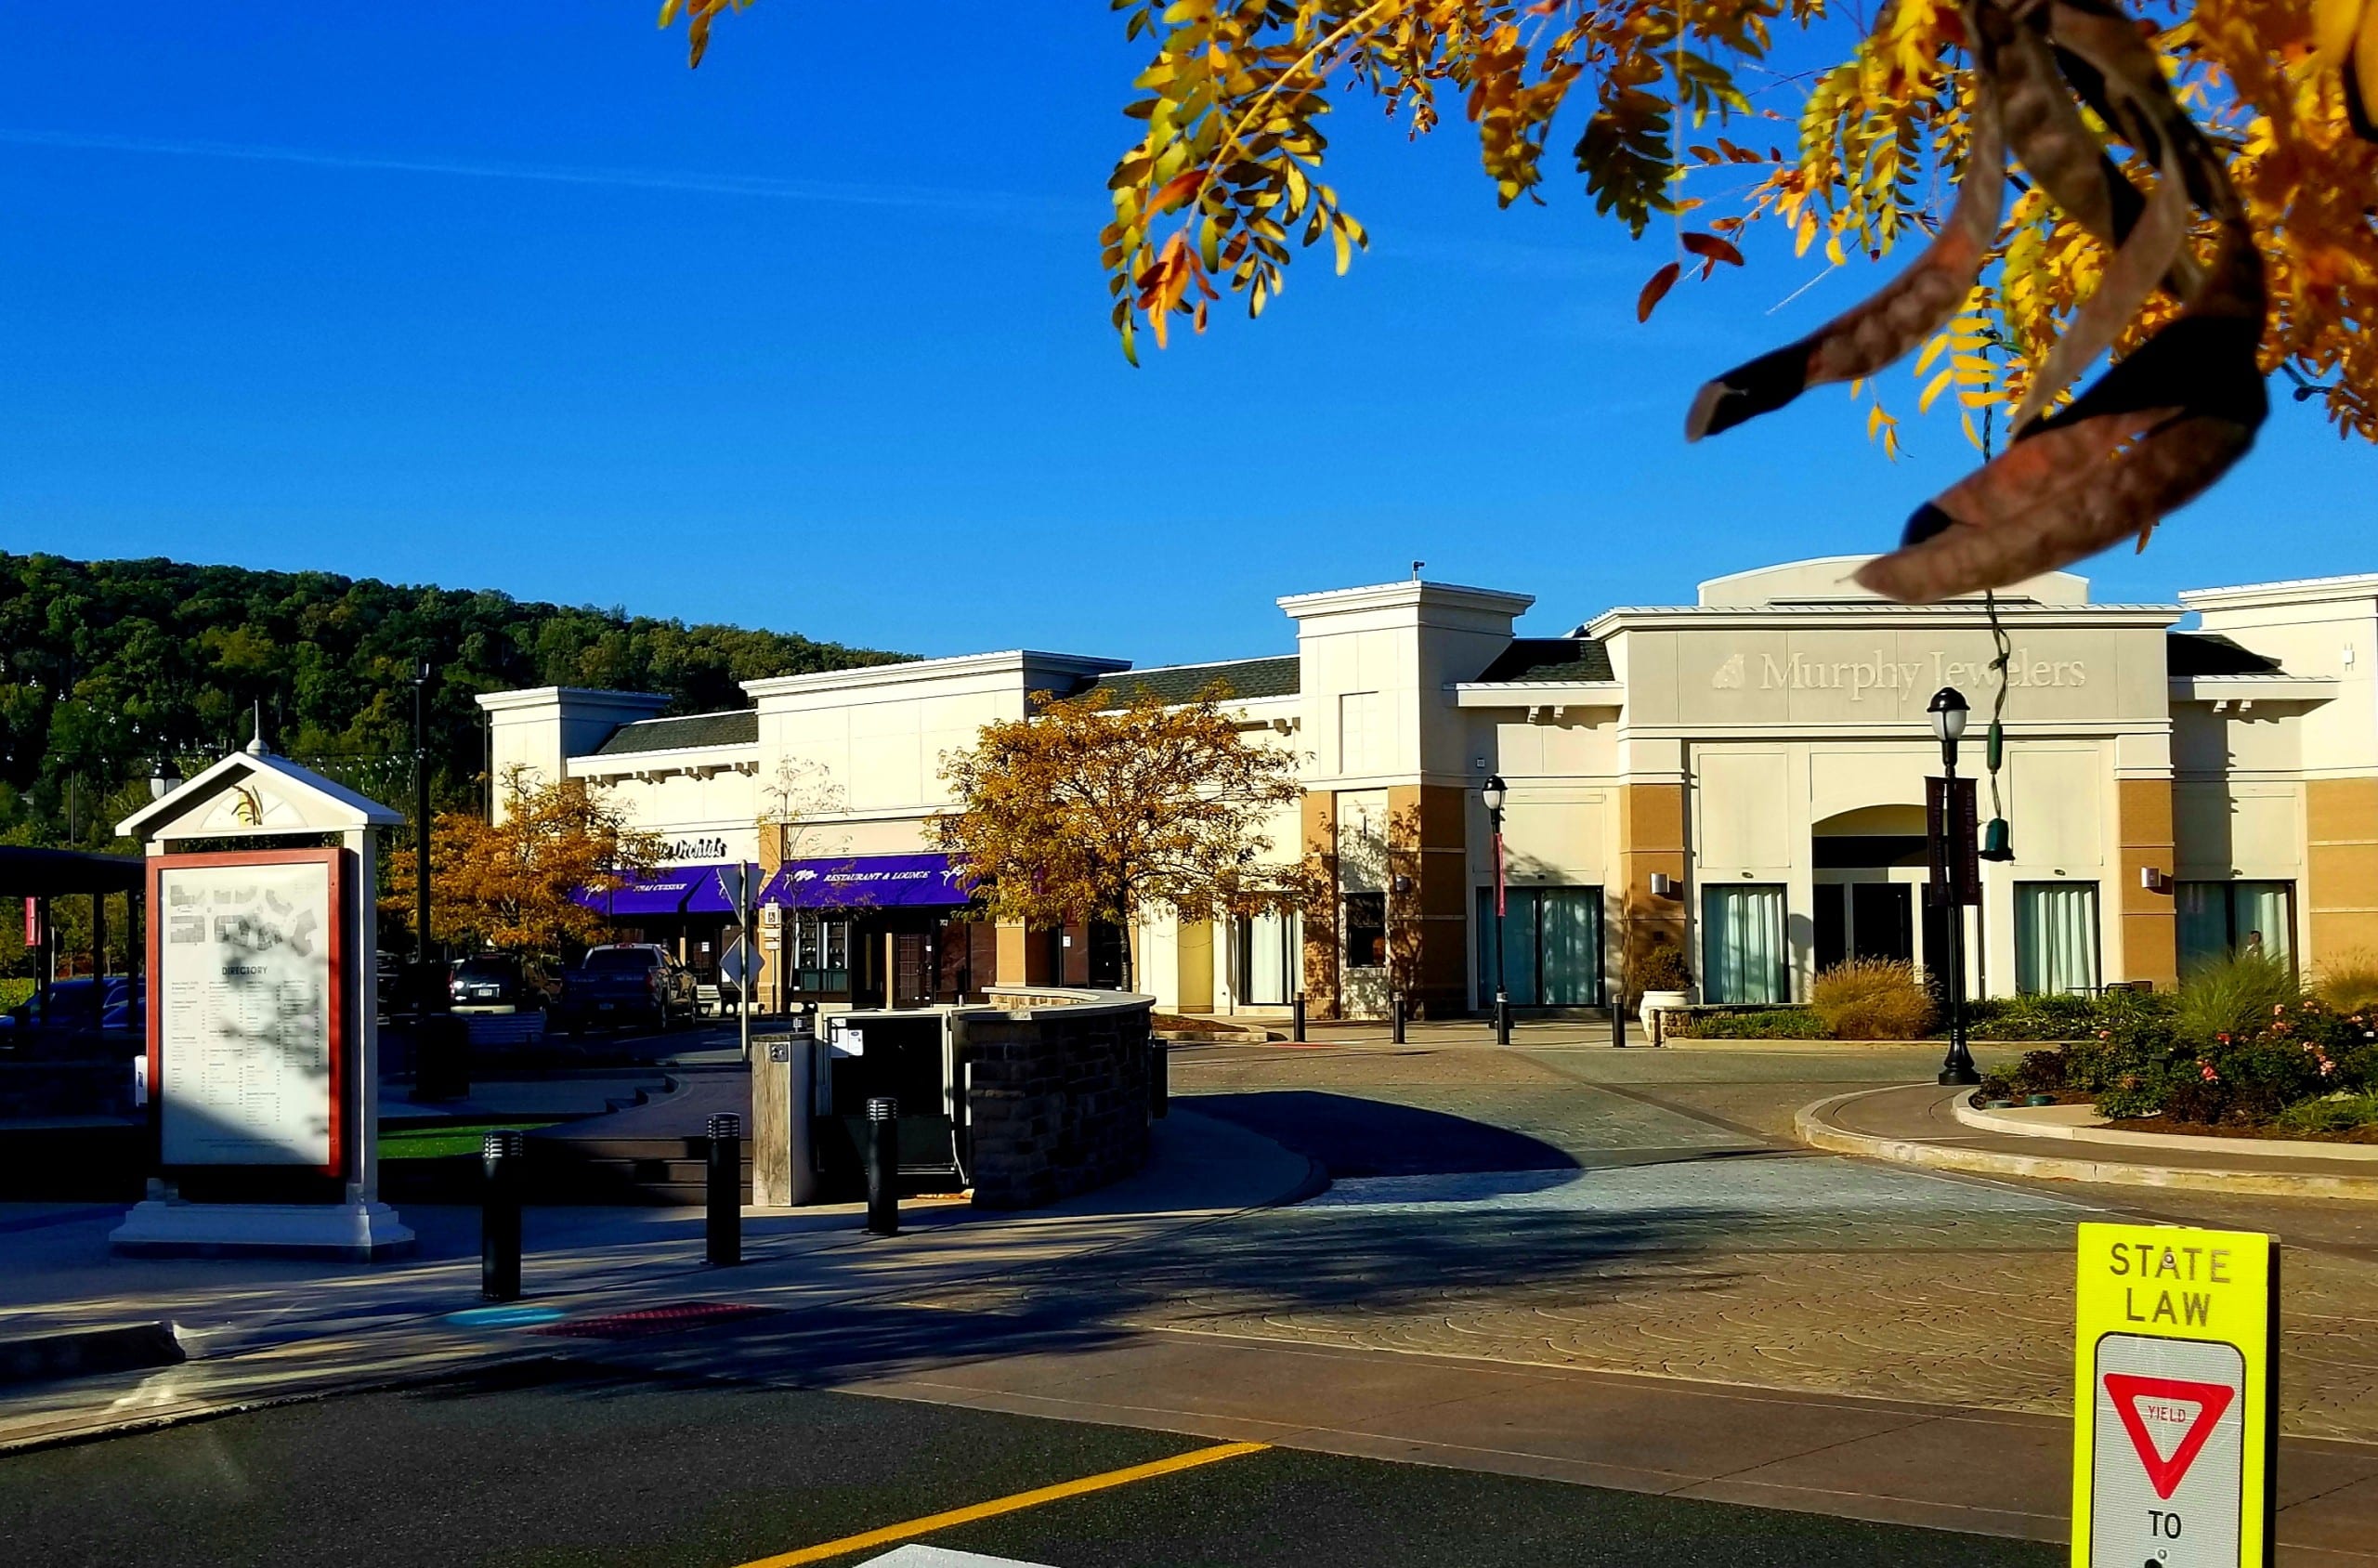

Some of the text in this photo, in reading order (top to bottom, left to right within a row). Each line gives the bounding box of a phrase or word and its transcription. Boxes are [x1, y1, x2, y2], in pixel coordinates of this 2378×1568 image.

[1761, 648, 2086, 701] Murphy Jewelers
[675, 837, 727, 859] Orchids
[823, 870, 931, 882] RESTAURANT & LOUNGE
[222, 965, 268, 975] DIRECTORY
[2109, 1242, 2231, 1284] STATE
[2125, 1287, 2211, 1326] LAW
[2148, 1405, 2187, 1423] YIELD
[2148, 1509, 2183, 1539] TO
